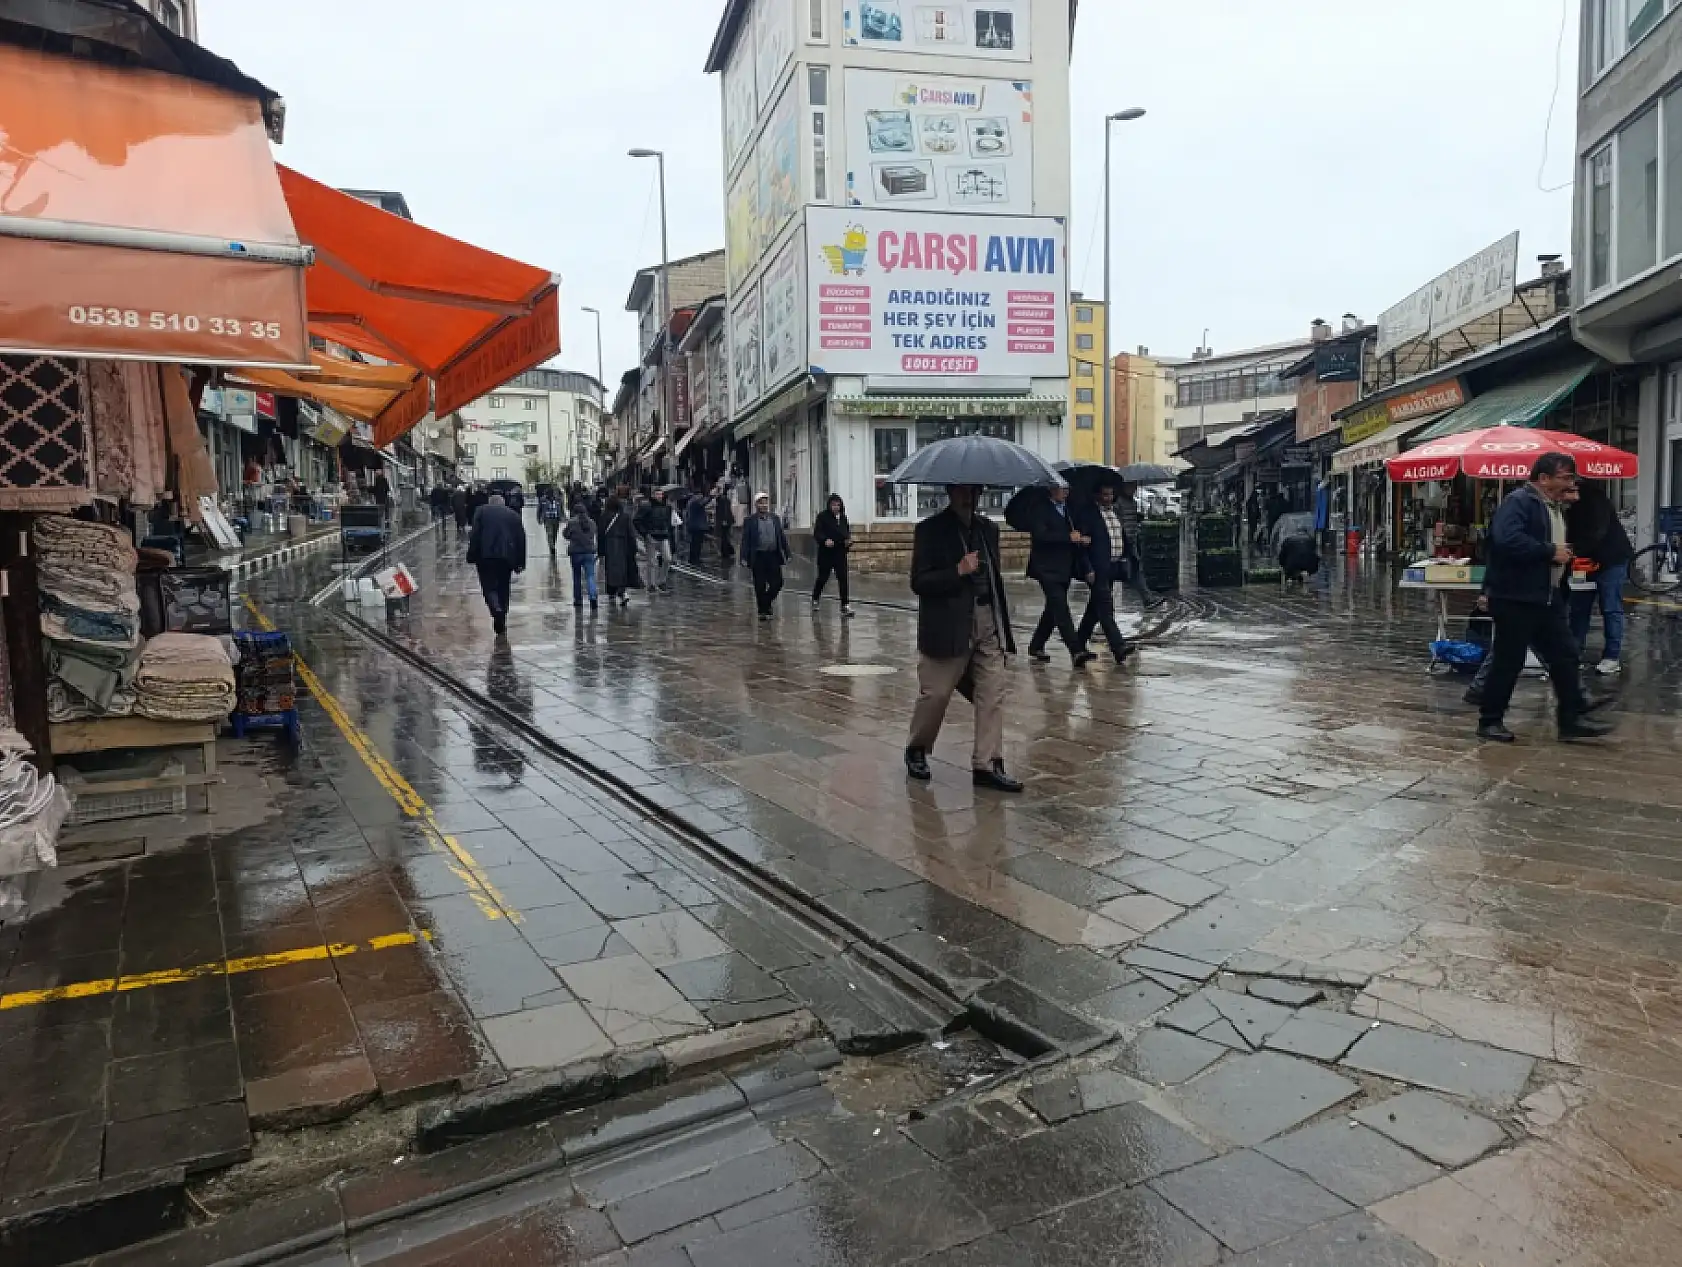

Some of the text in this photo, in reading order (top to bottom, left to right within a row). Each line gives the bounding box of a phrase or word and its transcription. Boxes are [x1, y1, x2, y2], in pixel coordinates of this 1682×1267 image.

[877, 230, 1056, 276] ÇARŞI AVM
[887, 287, 991, 307] ARADIĞINIZ
[68, 305, 281, 340] 0538 510 33 35
[883, 310, 996, 330] HER ŞEY İÇİN
[892, 333, 988, 350] TEK ADRES
[904, 356, 975, 373] 1001 ÇEŞİT
[1402, 463, 1447, 479] ALGIDA
